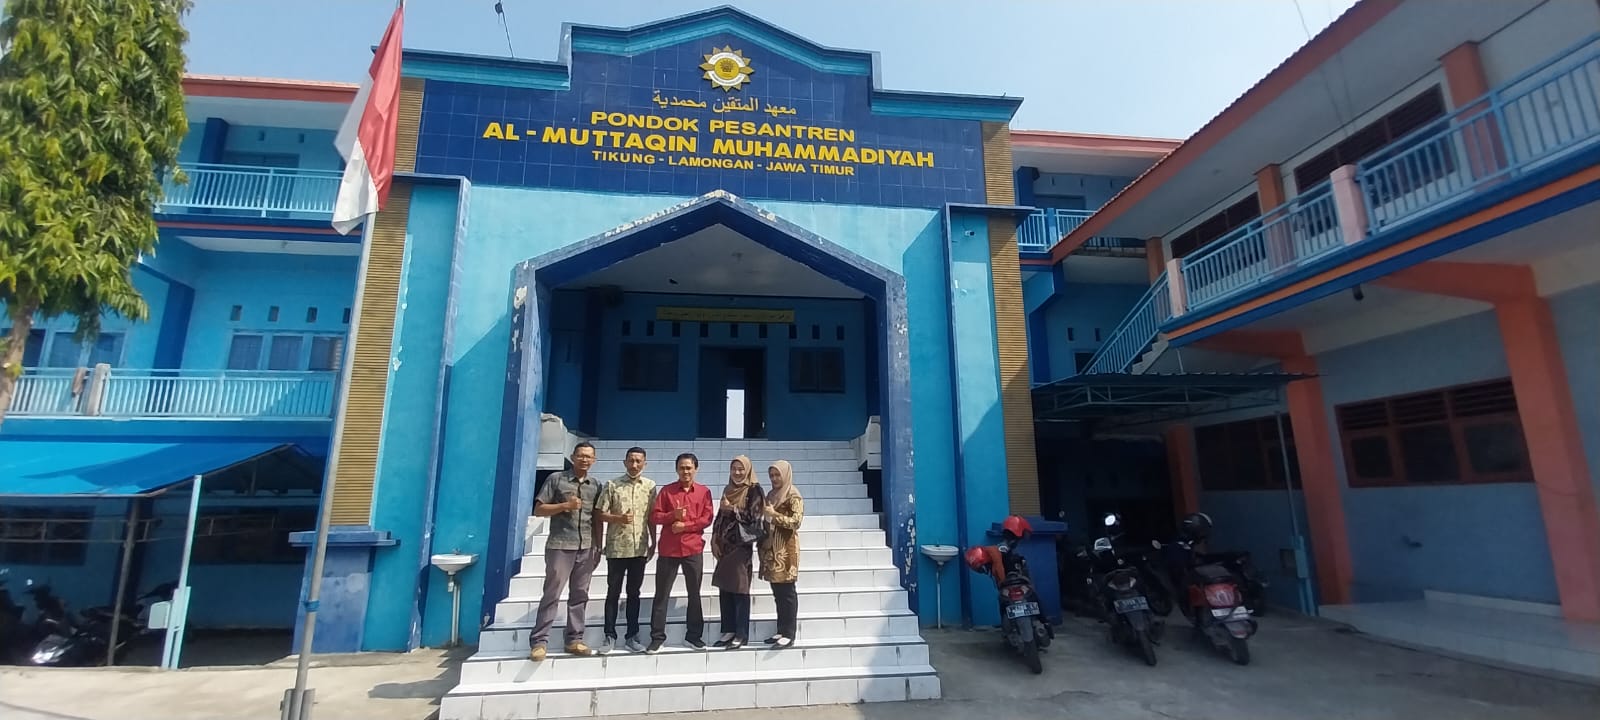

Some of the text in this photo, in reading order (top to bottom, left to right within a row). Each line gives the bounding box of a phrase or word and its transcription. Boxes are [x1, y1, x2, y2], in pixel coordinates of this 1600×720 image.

[652, 89, 797, 117] معهد المتقين محمدية
[591, 111, 855, 142] PONDOK PESANTREN
[483, 122, 519, 140] AL
[542, 127, 697, 153] MUTTAQIN
[712, 138, 934, 168] MUHAMMADIYAH
[592, 149, 656, 165] TIKUNG
[668, 156, 754, 170] LAMONGAN
[765, 161, 806, 173] JAWA
[811, 163, 855, 176] TIMUR
